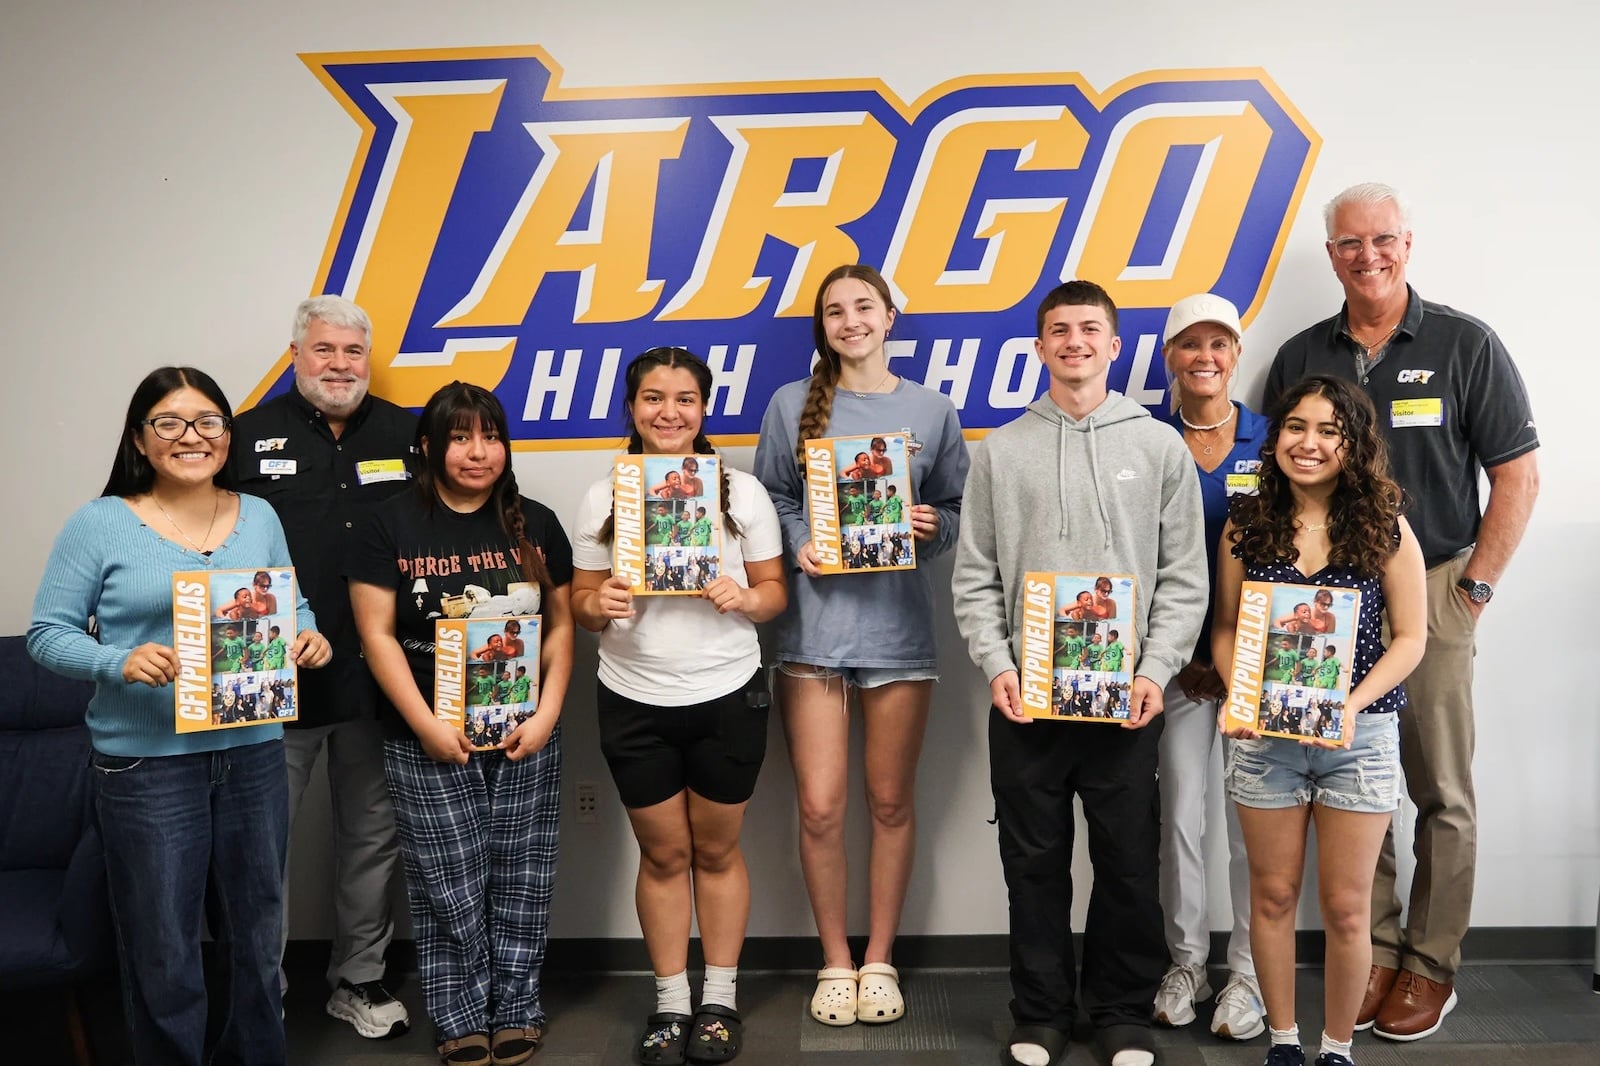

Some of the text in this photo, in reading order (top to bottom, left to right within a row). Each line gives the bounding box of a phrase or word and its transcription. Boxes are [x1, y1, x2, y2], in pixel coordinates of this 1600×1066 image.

[338, 78, 1273, 408] LARGO
[522, 334, 1166, 421] HIH HOL
[397, 555, 461, 580] PIERCE
[467, 551, 508, 573] THE
[176, 580, 208, 721] CFYPINELLAS
[437, 627, 463, 723] YPINELLAS
[1023, 579, 1051, 710] CFYPINELLAS
[1229, 589, 1268, 723] CFYPINELLAS
